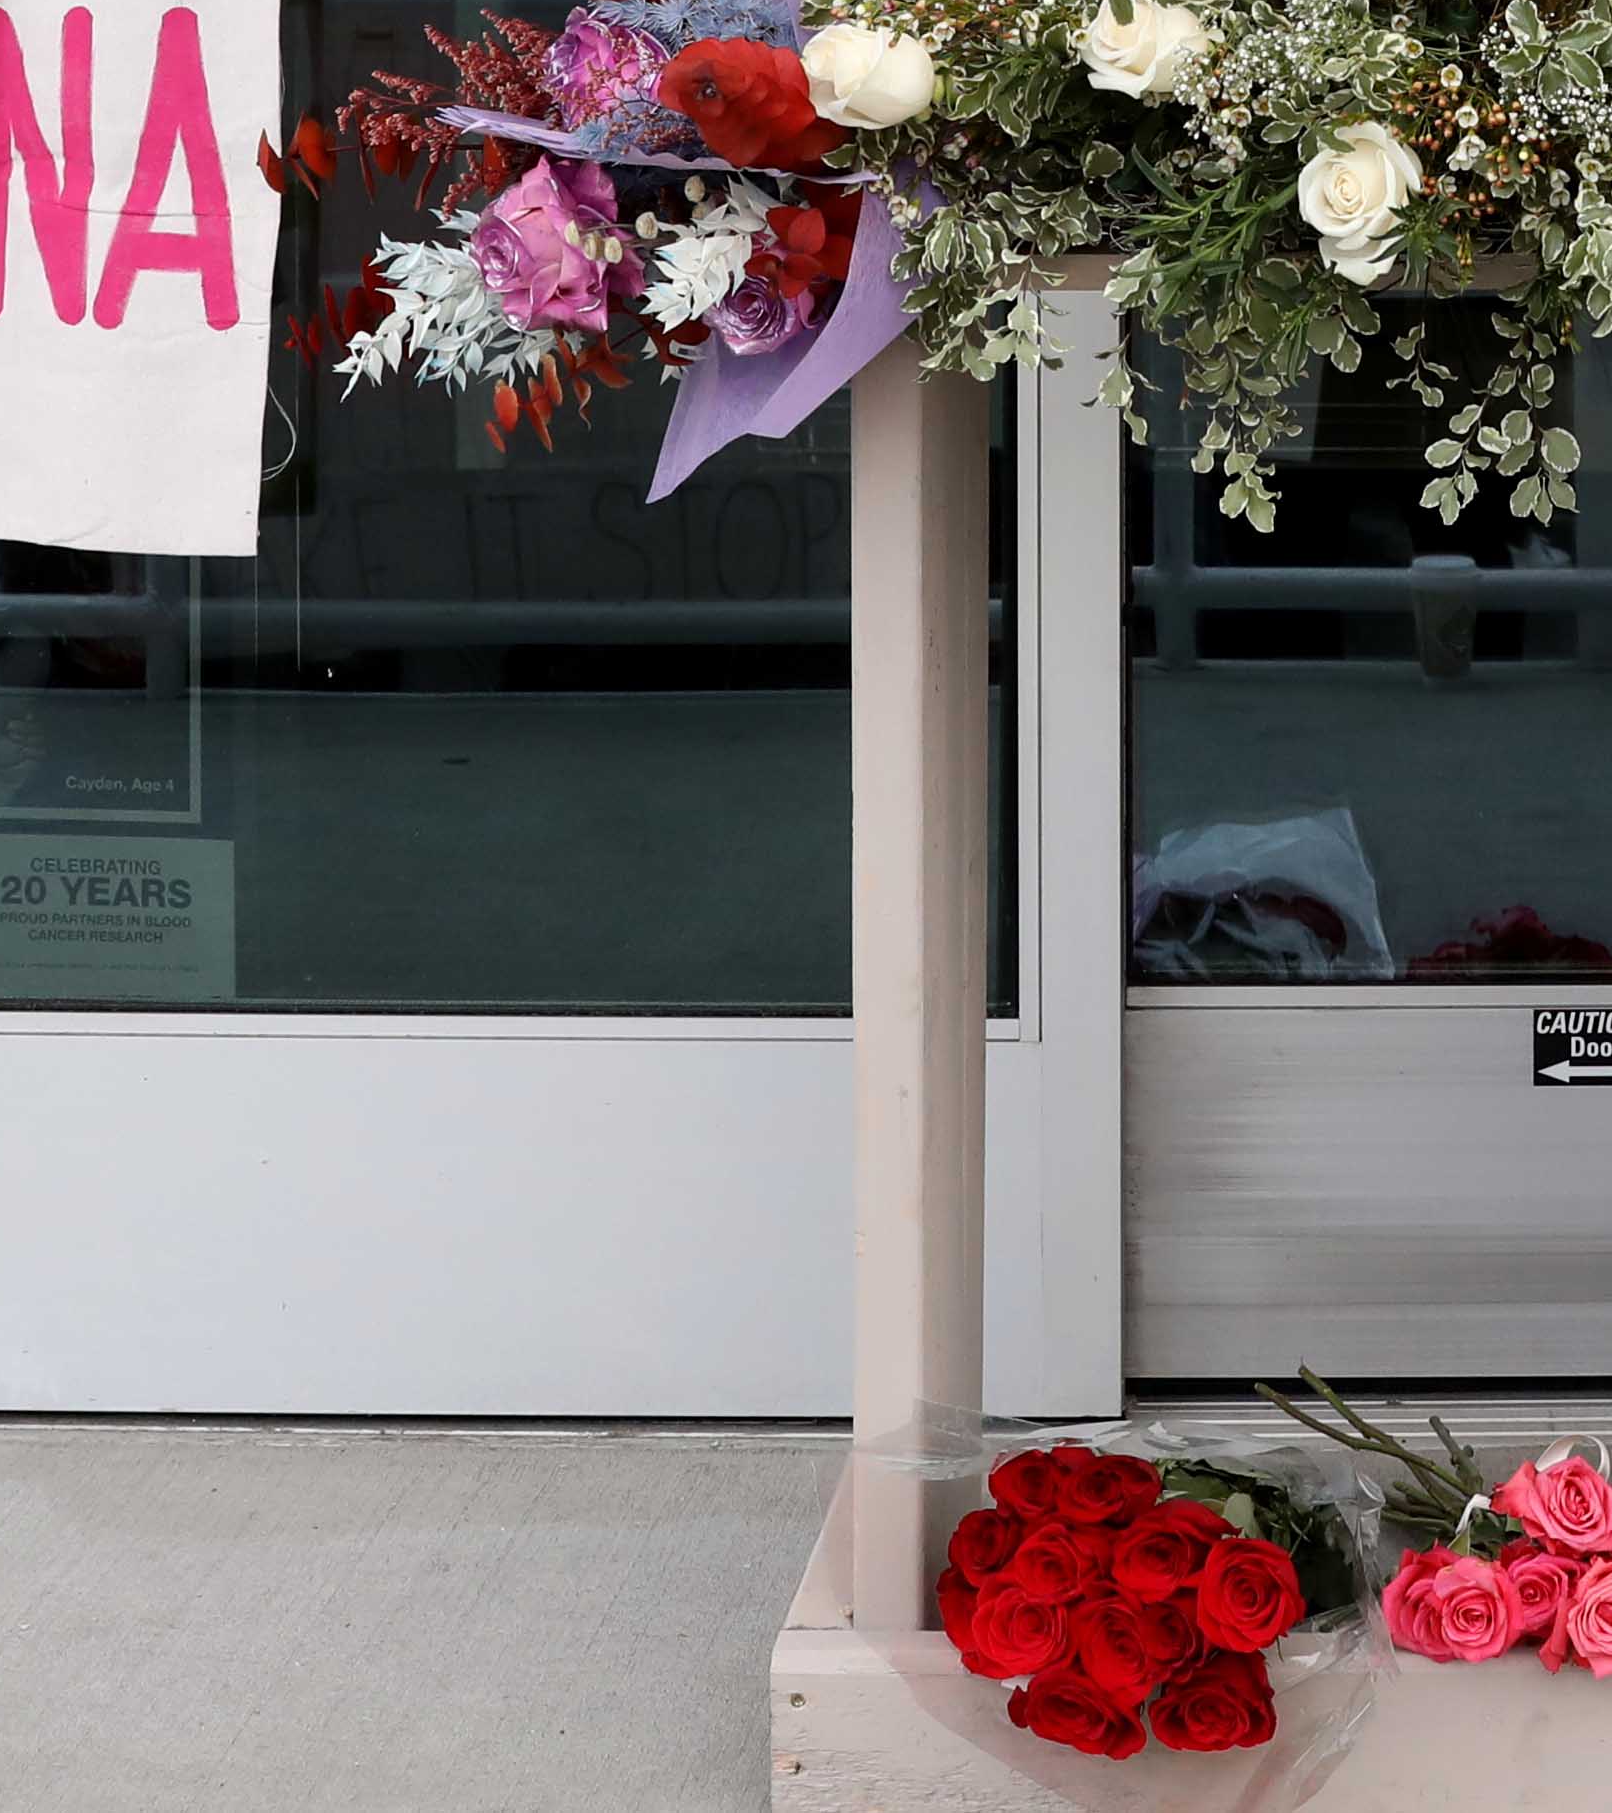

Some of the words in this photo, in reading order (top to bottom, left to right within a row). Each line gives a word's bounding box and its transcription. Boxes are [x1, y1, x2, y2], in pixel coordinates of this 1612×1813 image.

[132, 776, 162, 795] Age
[30, 857, 162, 876] CELEBRATING
[0, 875, 47, 905] 20
[60, 876, 194, 909] YEARS
[0, 911, 48, 925] PROUD
[51, 912, 124, 927] PARTNERS
[126, 914, 141, 927] IN
[144, 915, 192, 928] BLOOD
[27, 929, 85, 943] CANCER
[89, 930, 164, 945] RESEARCH
